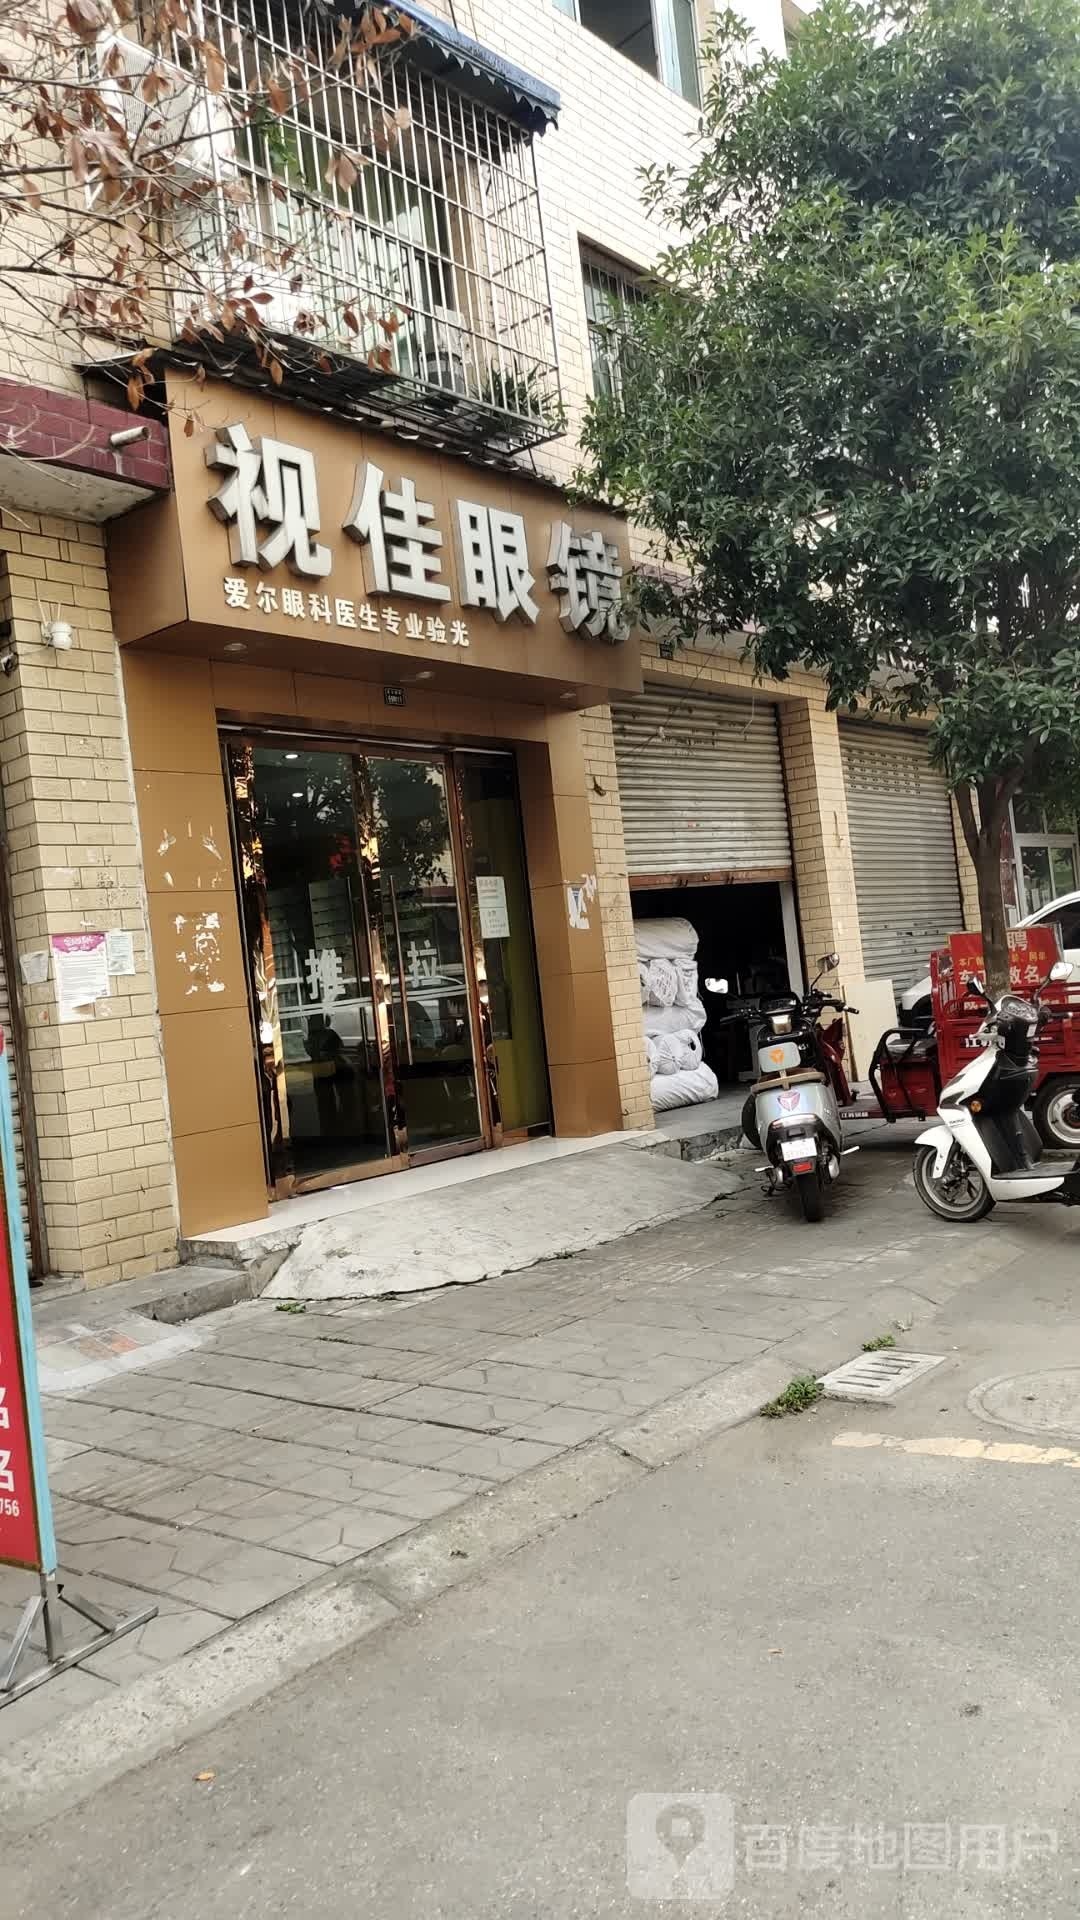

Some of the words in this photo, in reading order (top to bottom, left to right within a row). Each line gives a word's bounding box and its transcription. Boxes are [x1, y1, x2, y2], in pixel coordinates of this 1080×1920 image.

[206, 422, 630, 645] 视佳眼镜
[224, 576, 470, 647] 爱尔眼科医生专业验光
[406, 940, 441, 988] 拉
